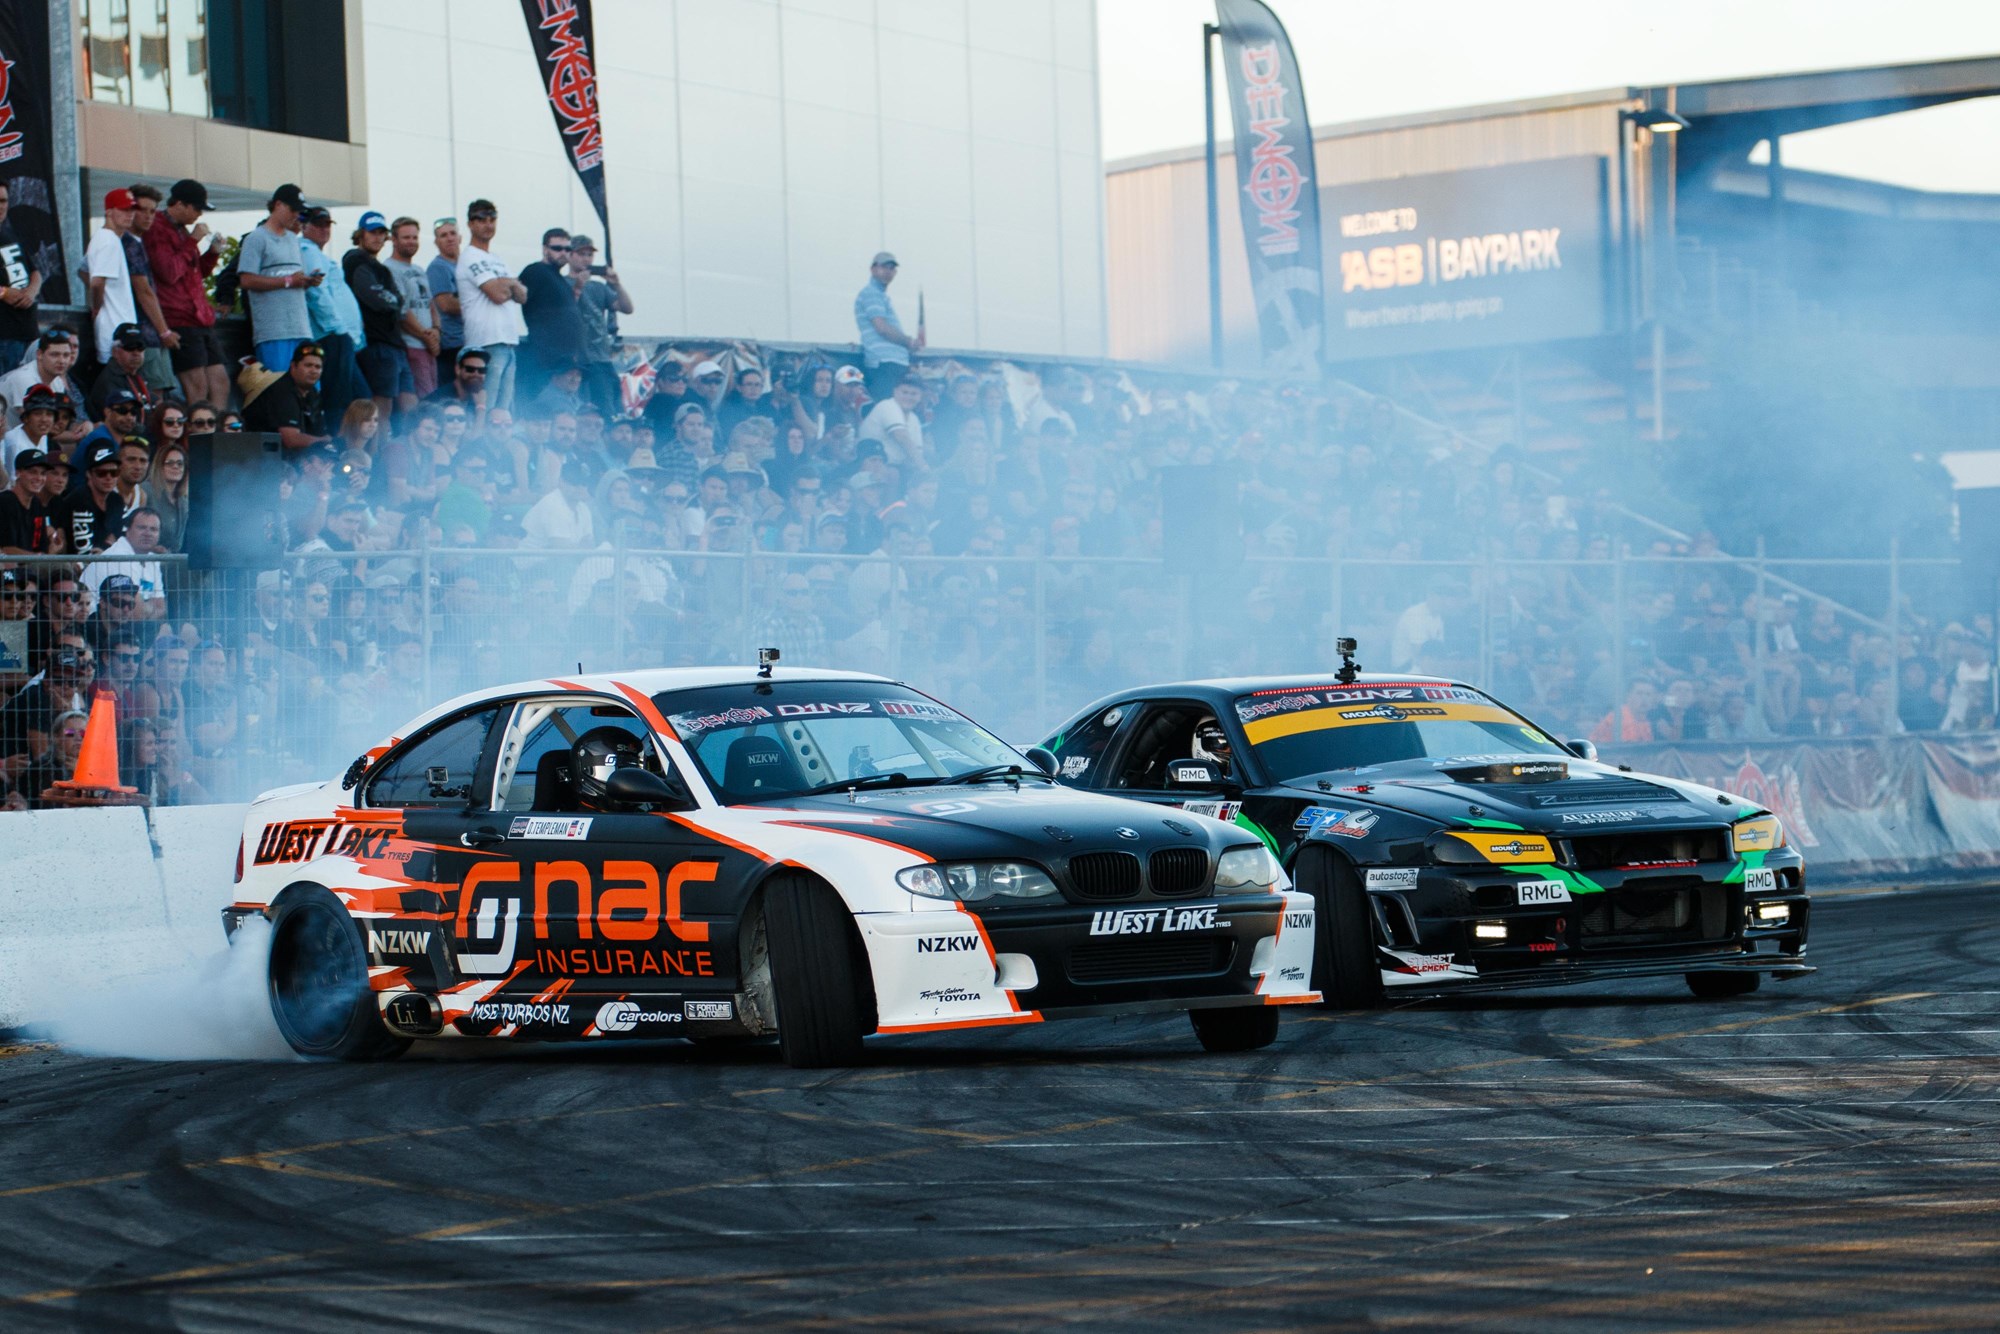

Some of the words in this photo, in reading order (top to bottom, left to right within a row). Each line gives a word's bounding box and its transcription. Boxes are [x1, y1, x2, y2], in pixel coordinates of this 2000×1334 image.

[1340, 243, 1423, 293] ASB
[1439, 227, 1561, 281] BAYPARK
[1325, 688, 1414, 702] D1NZ
[777, 702, 873, 717] D1NZ
[1342, 709, 1391, 720] MOUNT
[1395, 707, 1443, 717] SHOP
[748, 753, 779, 766] NZKW
[1180, 769, 1206, 779] RMC
[1227, 804, 1239, 820] 02
[1562, 810, 1642, 822] AUTOSURE
[527, 821, 570, 835] D.TEMPLEMAN
[254, 822, 326, 866] WEST
[323, 822, 398, 860] LAKE
[387, 850, 413, 862] TYRES
[1490, 844, 1517, 852] MOUNT
[1518, 844, 1545, 852] SHOP
[1369, 871, 1409, 882] autostop
[1747, 872, 1772, 888] RMC
[1521, 884, 1563, 901] RMC
[1089, 910, 1159, 936] WEST
[1163, 906, 1218, 932] LAKE
[1285, 913, 1313, 929] NZKW
[368, 930, 431, 954] NZKW
[917, 935, 979, 953] NZKW
[1528, 943, 1556, 952] TOW
[536, 949, 715, 976] INSURANCE
[1407, 952, 1456, 965] STREET
[938, 993, 981, 1002] TOYOTA
[471, 1001, 500, 1023] MSE
[500, 1002, 550, 1029] TURBOS
[550, 1003, 570, 1025] NZ
[618, 1010, 682, 1023] carcolors
